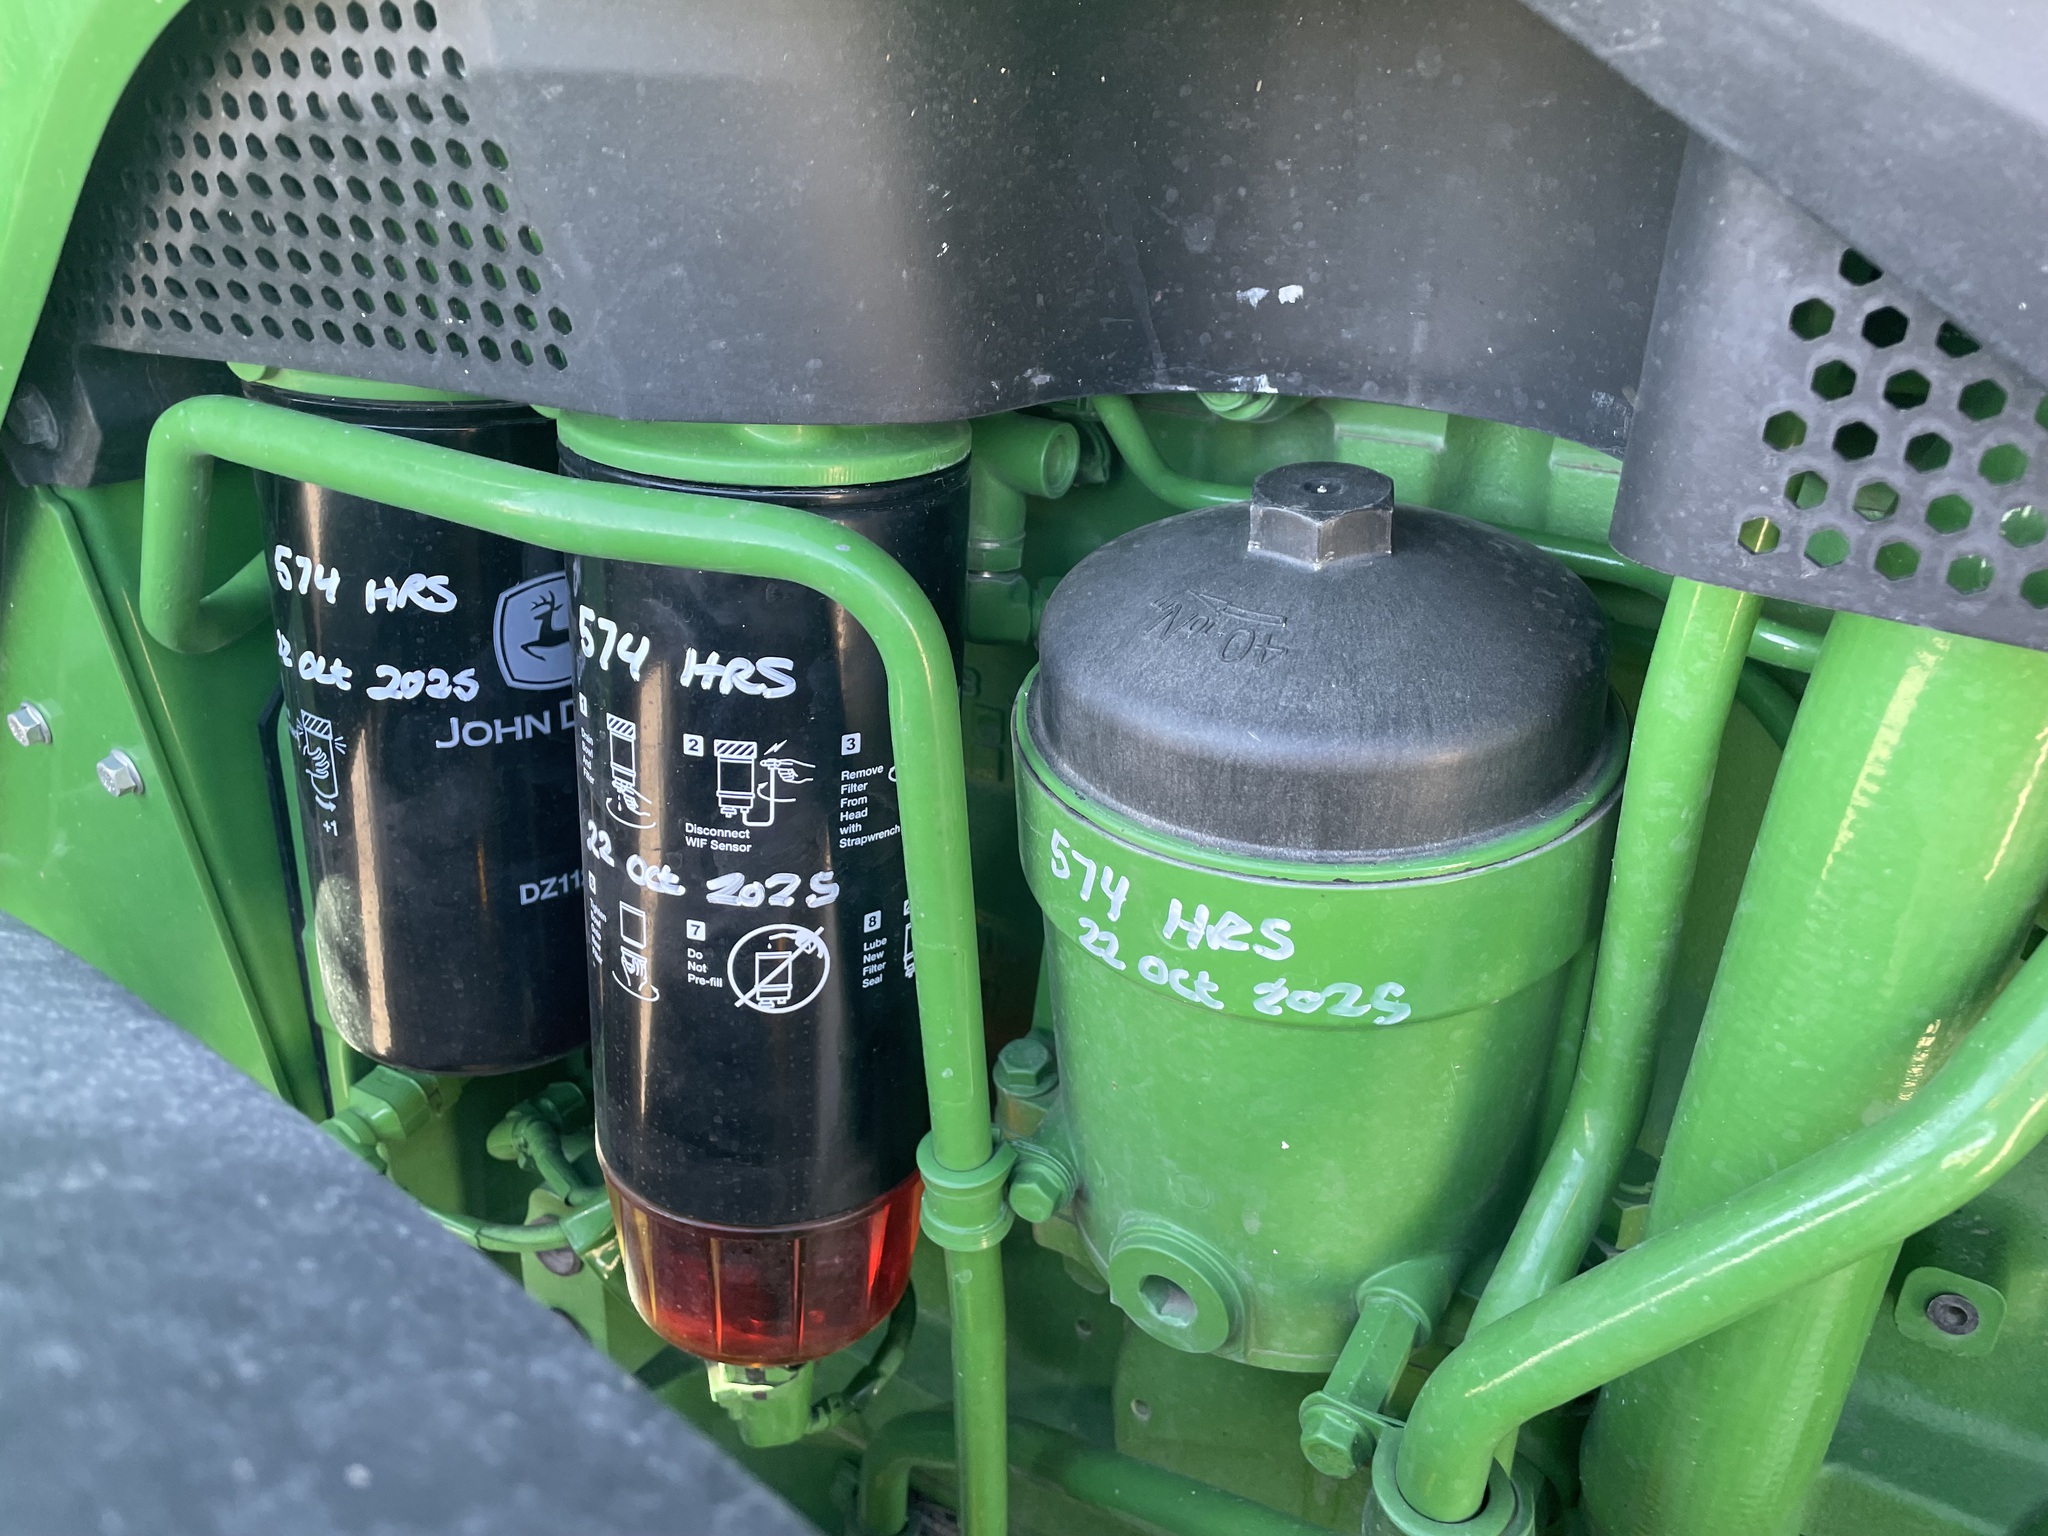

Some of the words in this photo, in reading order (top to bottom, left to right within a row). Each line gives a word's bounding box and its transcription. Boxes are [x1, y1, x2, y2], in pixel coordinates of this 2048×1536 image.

[274, 545, 341, 604] 574
[365, 573, 457, 614] HRS
[579, 604, 650, 682] 574
[680, 647, 797, 699] HRS
[366, 664, 480, 702] 2025
[435, 710, 551, 749] JOHN
[841, 765, 884, 781] Remove
[840, 782, 869, 795] Filter
[840, 796, 868, 809] From
[840, 807, 869, 822] Head
[685, 822, 751, 839] Disconnect
[839, 823, 863, 836] with
[839, 823, 901, 849] Strapwrench
[685, 836, 708, 849] WIF
[710, 840, 752, 853] Sensor
[587, 819, 615, 868] 22
[625, 854, 686, 896] Oct
[706, 870, 840, 909] 2025
[520, 868, 583, 906] DZ11
[1051, 828, 1130, 922] 574
[1162, 898, 1295, 961] HRS
[863, 937, 887, 952] Lube
[687, 948, 703, 960] Do
[863, 950, 885, 964] New
[687, 961, 707, 974] Not
[862, 961, 887, 976] Filter
[1078, 917, 1126, 971] 22
[1138, 955, 1225, 1010] Oct
[1253, 977, 1411, 1026] 2025
[687, 974, 723, 988] Pre-fill
[862, 973, 883, 988] Seal
